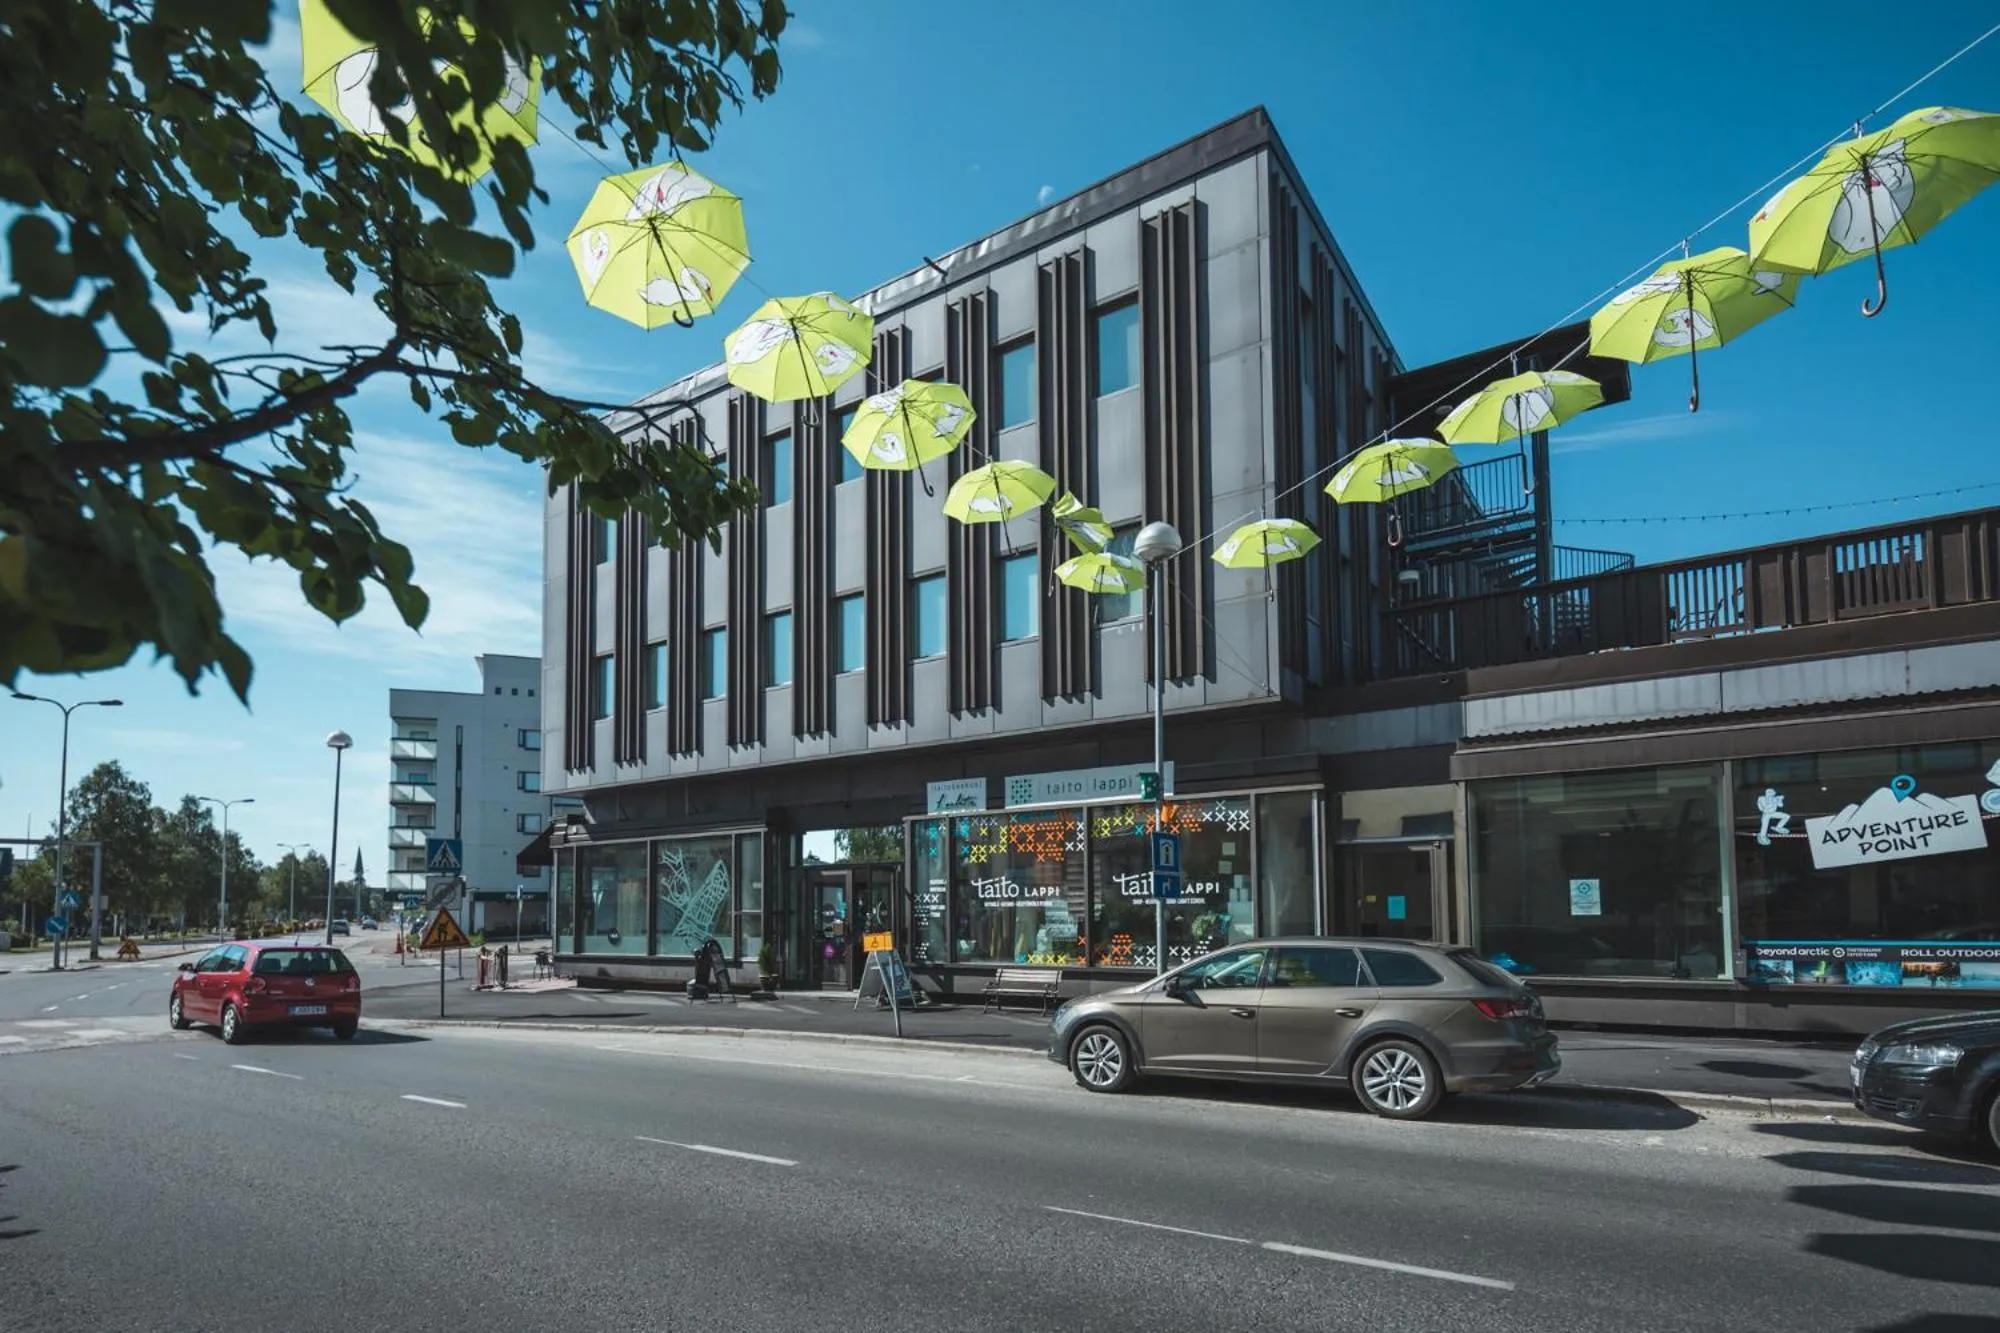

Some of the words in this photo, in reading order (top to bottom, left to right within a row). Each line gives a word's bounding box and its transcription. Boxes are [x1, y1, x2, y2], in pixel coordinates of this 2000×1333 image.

[1047, 781, 1082, 795] taito
[1093, 774, 1133, 791] lappi
[1822, 810, 1969, 845] ADVENTURE
[1858, 832, 1933, 855] POINT
[1024, 886, 1060, 897] LAPPI
[1798, 947, 1830, 956] arctic
[1901, 949, 1934, 957] ROLL
